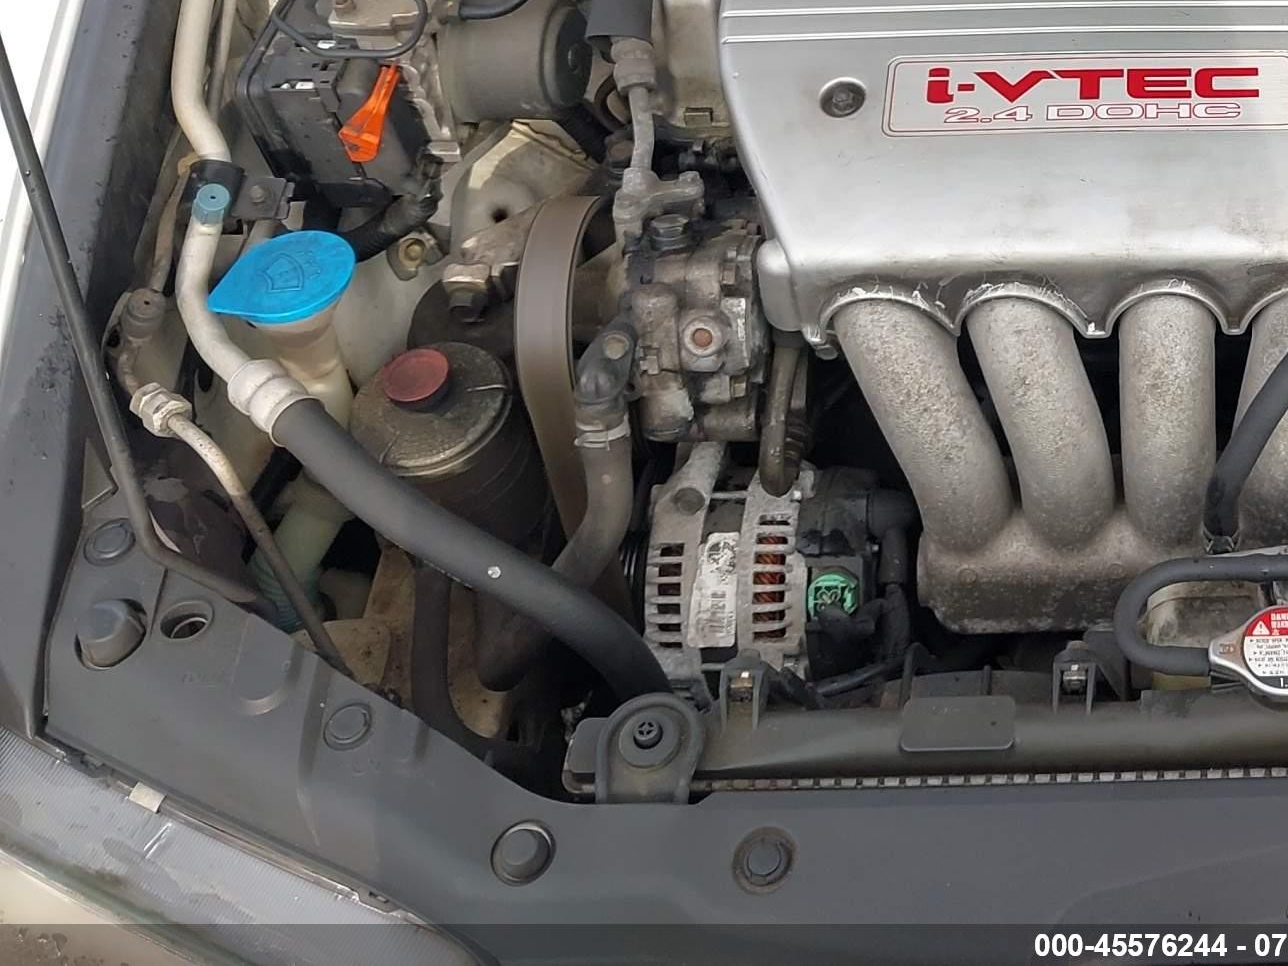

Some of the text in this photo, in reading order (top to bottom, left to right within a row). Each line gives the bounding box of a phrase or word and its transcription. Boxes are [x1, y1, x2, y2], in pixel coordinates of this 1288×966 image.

[926, 66, 1260, 104] i-VTEC
[943, 102, 1241, 124] 2.4 DOHC
